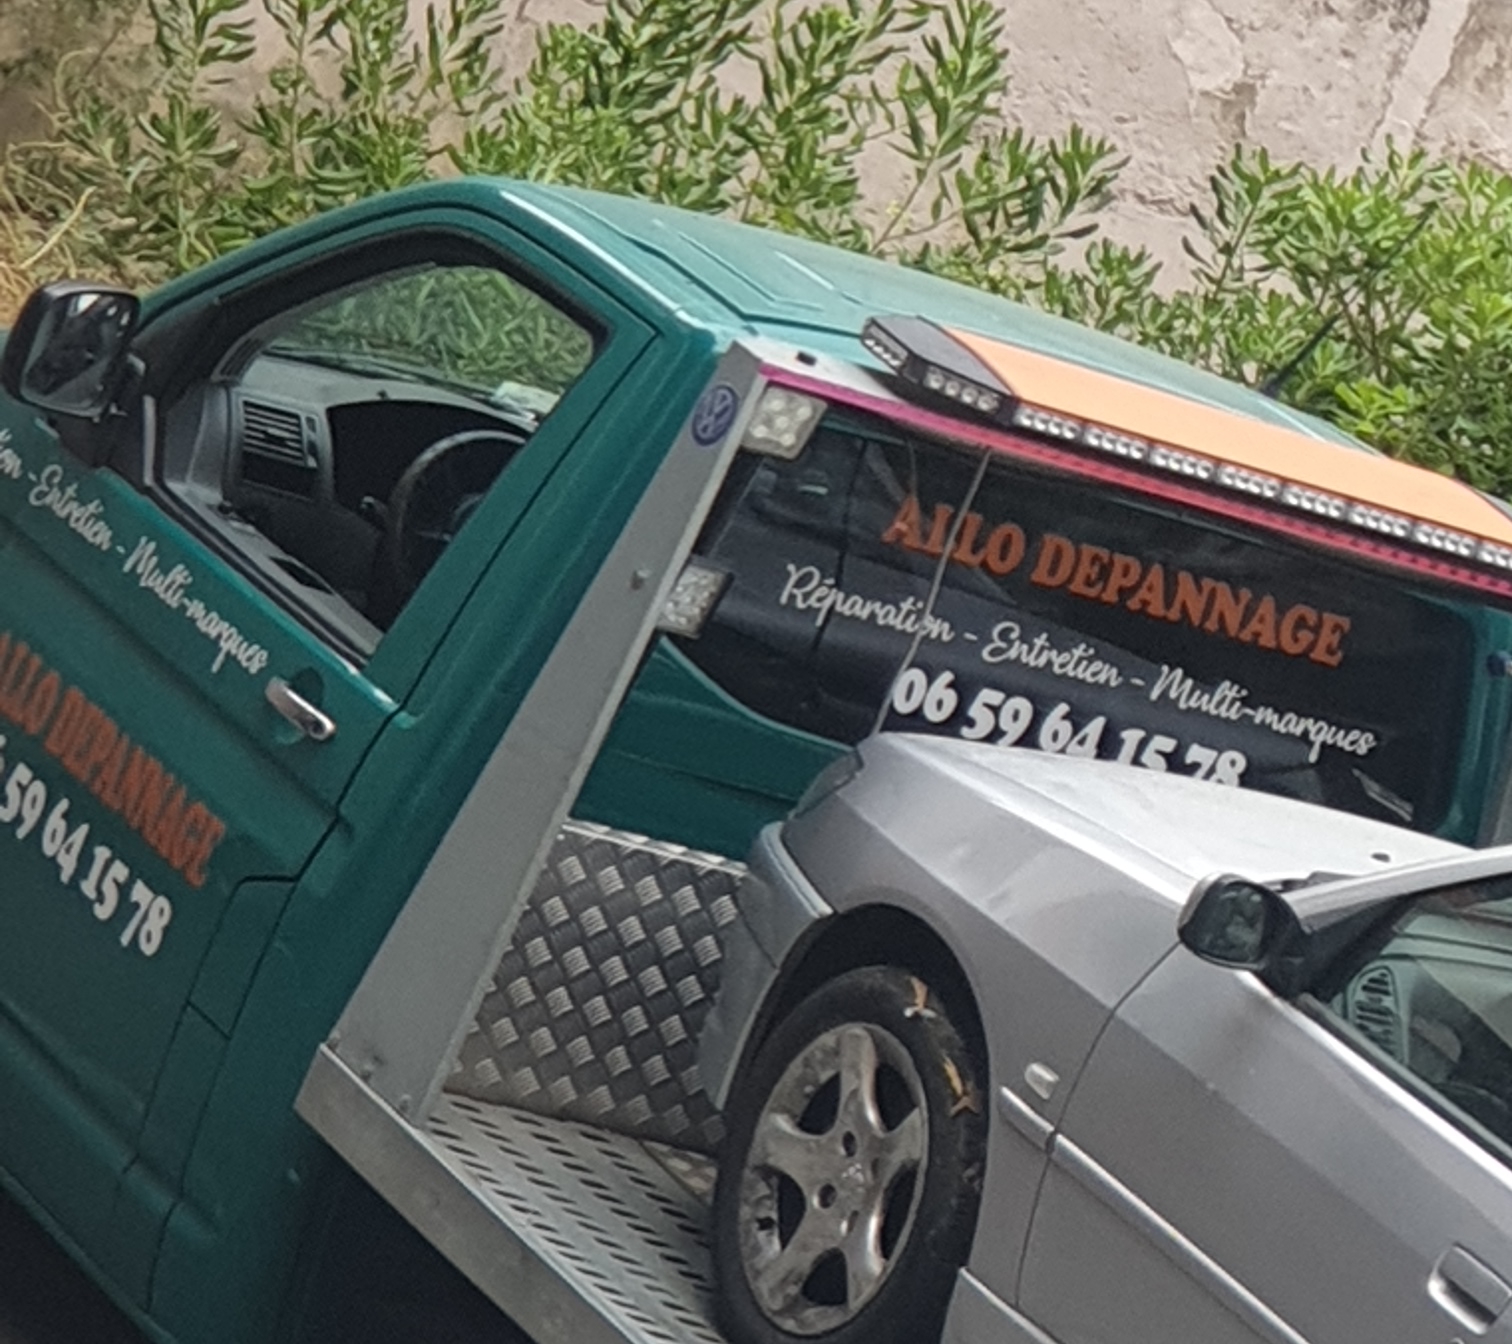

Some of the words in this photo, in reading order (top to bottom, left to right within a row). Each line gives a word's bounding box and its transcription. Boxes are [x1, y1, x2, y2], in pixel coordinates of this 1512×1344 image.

[29, 464, 112, 551] Entretien
[122, 535, 268, 674] Multi-marques
[780, 563, 955, 642] Réparation
[982, 621, 1123, 688] Entretien
[1149, 664, 1378, 764] Multi-marques
[880, 494, 1025, 575] ALLO
[1029, 533, 1351, 668] DEPANNAGE
[44, 686, 226, 888] DEPANNAGE
[892, 667, 959, 723] 06
[960, 688, 1034, 748] 59
[1039, 702, 1107, 760] 64
[0, 762, 47, 840] 59
[42, 798, 90, 885] 64
[80, 845, 130, 921] 15
[120, 878, 173, 957] 78
